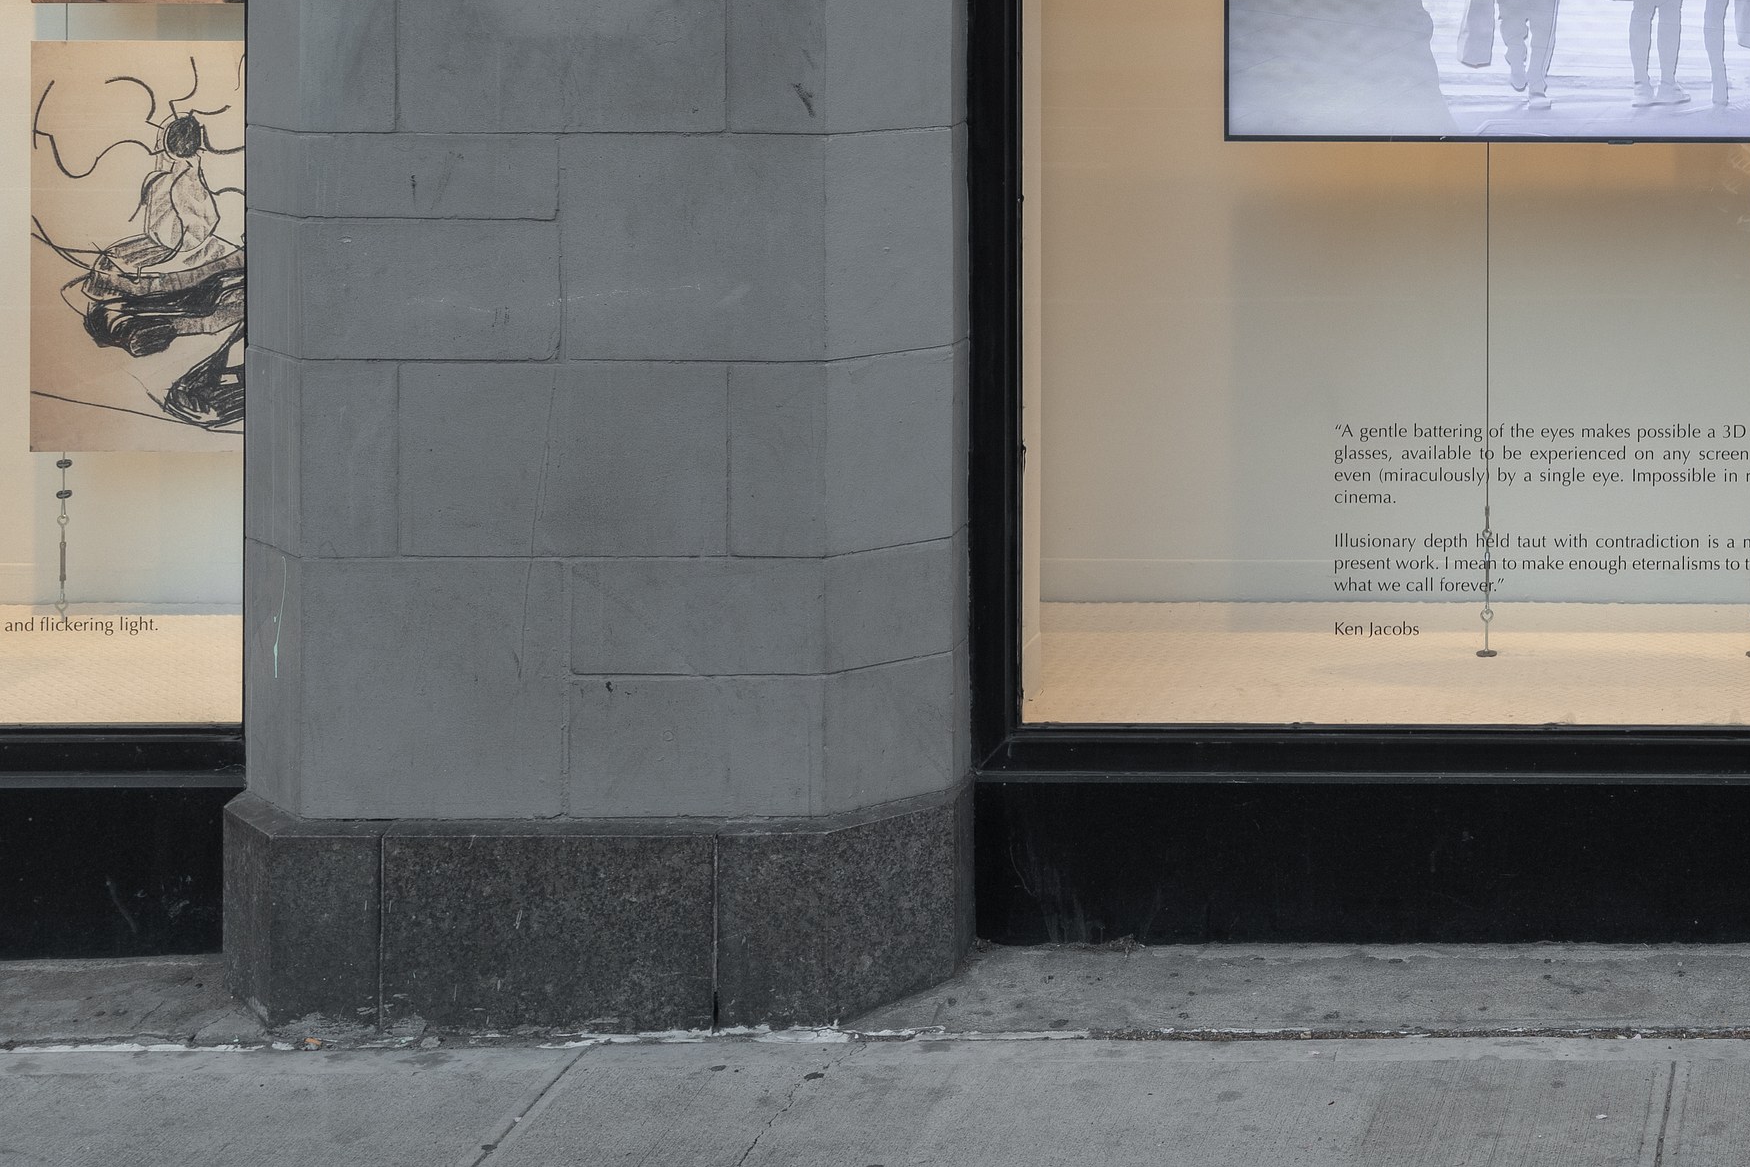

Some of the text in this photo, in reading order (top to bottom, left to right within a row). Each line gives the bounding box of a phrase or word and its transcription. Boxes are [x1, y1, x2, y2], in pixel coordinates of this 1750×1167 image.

[1360, 423, 1407, 442] gentle
[1414, 423, 1482, 442] battering
[1488, 423, 1504, 438] of
[1511, 423, 1534, 438] the
[1541, 428, 1574, 442] eyes
[1582, 423, 1630, 438] makes
[1638, 423, 1701, 442] possible
[1708, 428, 1715, 438] a
[1723, 425, 1746, 438] 3D
[1335, 445, 1392, 464] glasses,
[1402, 445, 1471, 460] available
[1480, 446, 1494, 460] to
[1503, 445, 1521, 460] be
[1530, 445, 1625, 464] experienced
[1635, 450, 1653, 460] on
[1663, 450, 1690, 465] any
[1699, 450, 1748, 460] screen
[1335, 472, 1370, 482] even
[1379, 467, 1489, 487] (miraculously)
[1498, 467, 1516, 486] by
[1524, 472, 1531, 482] a
[1540, 467, 1585, 487] single
[1593, 472, 1623, 486] eye.
[1633, 467, 1716, 487] Impossible
[1725, 469, 1737, 482] in
[1335, 490, 1396, 503] cinema.
[1335, 533, 1416, 552] Illusionary
[1424, 533, 1467, 552] depth
[1477, 533, 1509, 548] held
[1518, 536, 1546, 548] taut
[1554, 533, 1587, 548] with
[1596, 533, 1699, 548] contradiction
[1709, 534, 1719, 548] is
[1727, 538, 1734, 548] a
[1335, 558, 1390, 574] present
[1396, 555, 1438, 569] work.
[1455, 560, 1496, 570] mean
[1503, 558, 1516, 570] to
[1523, 555, 1564, 570] make
[1569, 555, 1626, 575] enough
[1633, 555, 1720, 570] eternalisms
[1725, 558, 1740, 570] to
[1334, 577, 1372, 591] what
[1378, 582, 1400, 592] we
[1406, 577, 1433, 592] call
[4, 616, 159, 635] and flickering light.
[1335, 621, 1419, 638] Ken Jacobs
